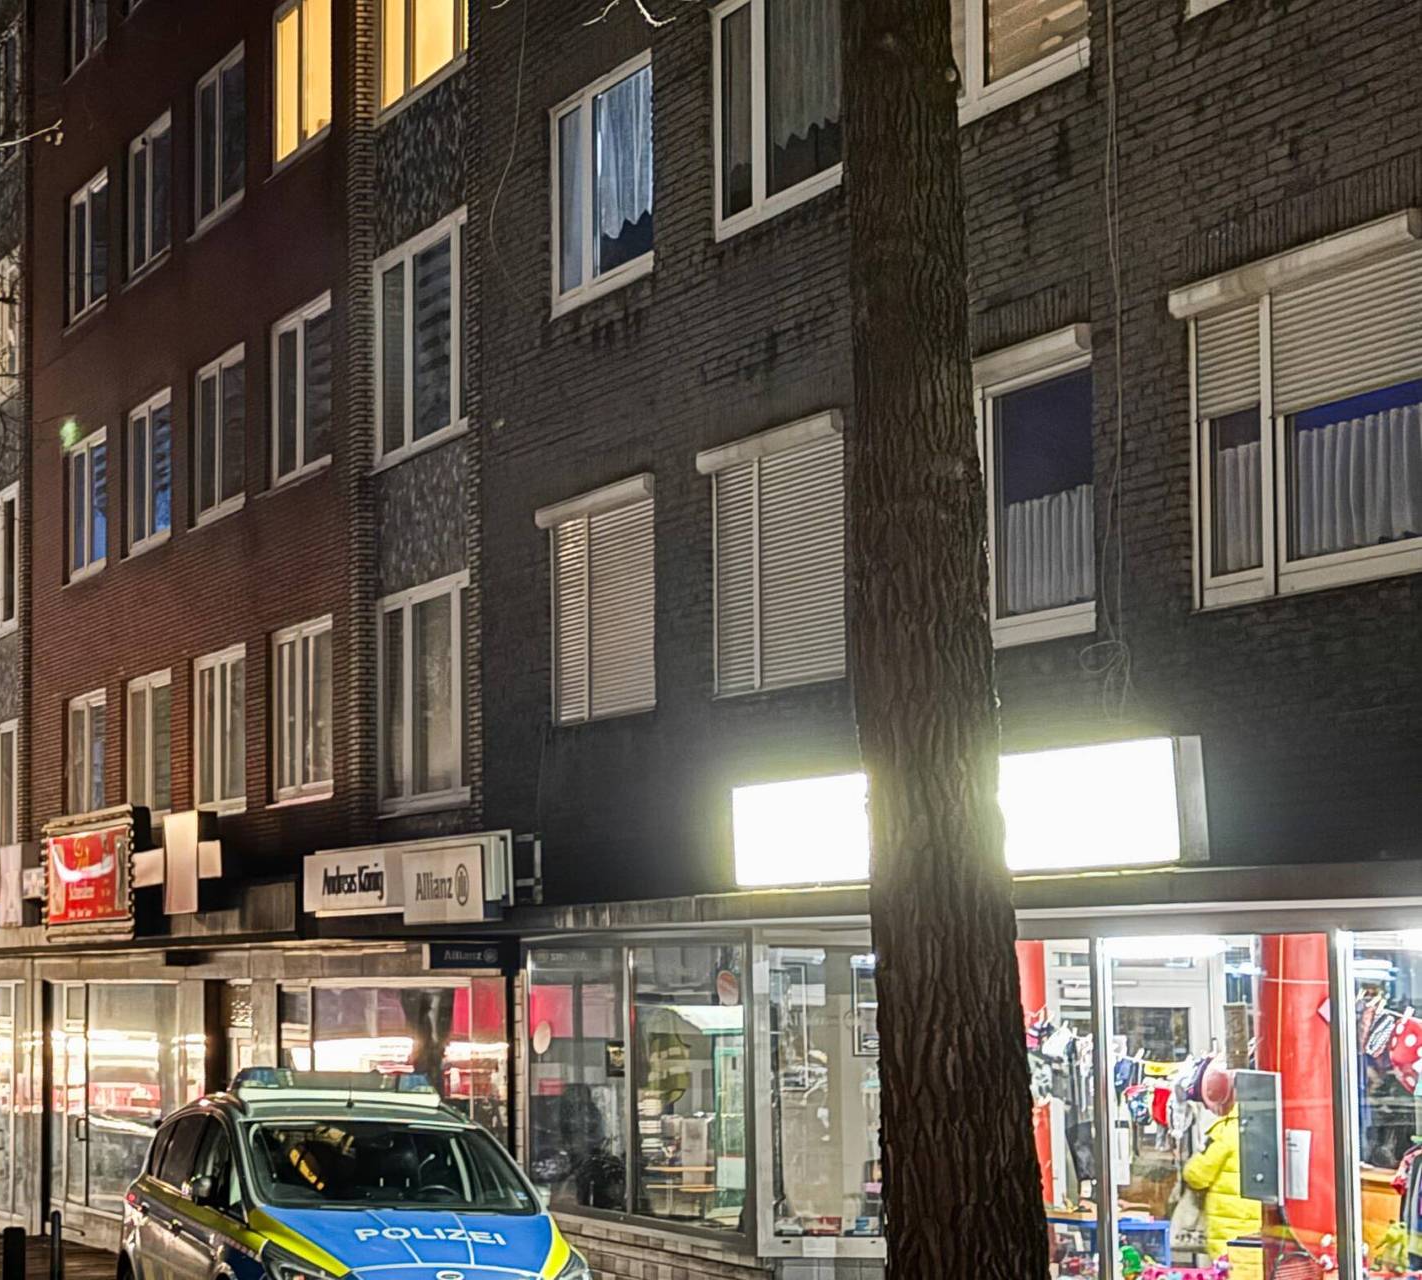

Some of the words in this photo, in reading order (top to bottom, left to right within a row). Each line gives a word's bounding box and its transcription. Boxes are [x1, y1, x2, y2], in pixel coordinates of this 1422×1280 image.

[322, 865, 357, 896] Andreas
[416, 872, 453, 901] Allianz
[443, 950, 483, 961] Allianz
[354, 1227, 506, 1245] POLIZEI
